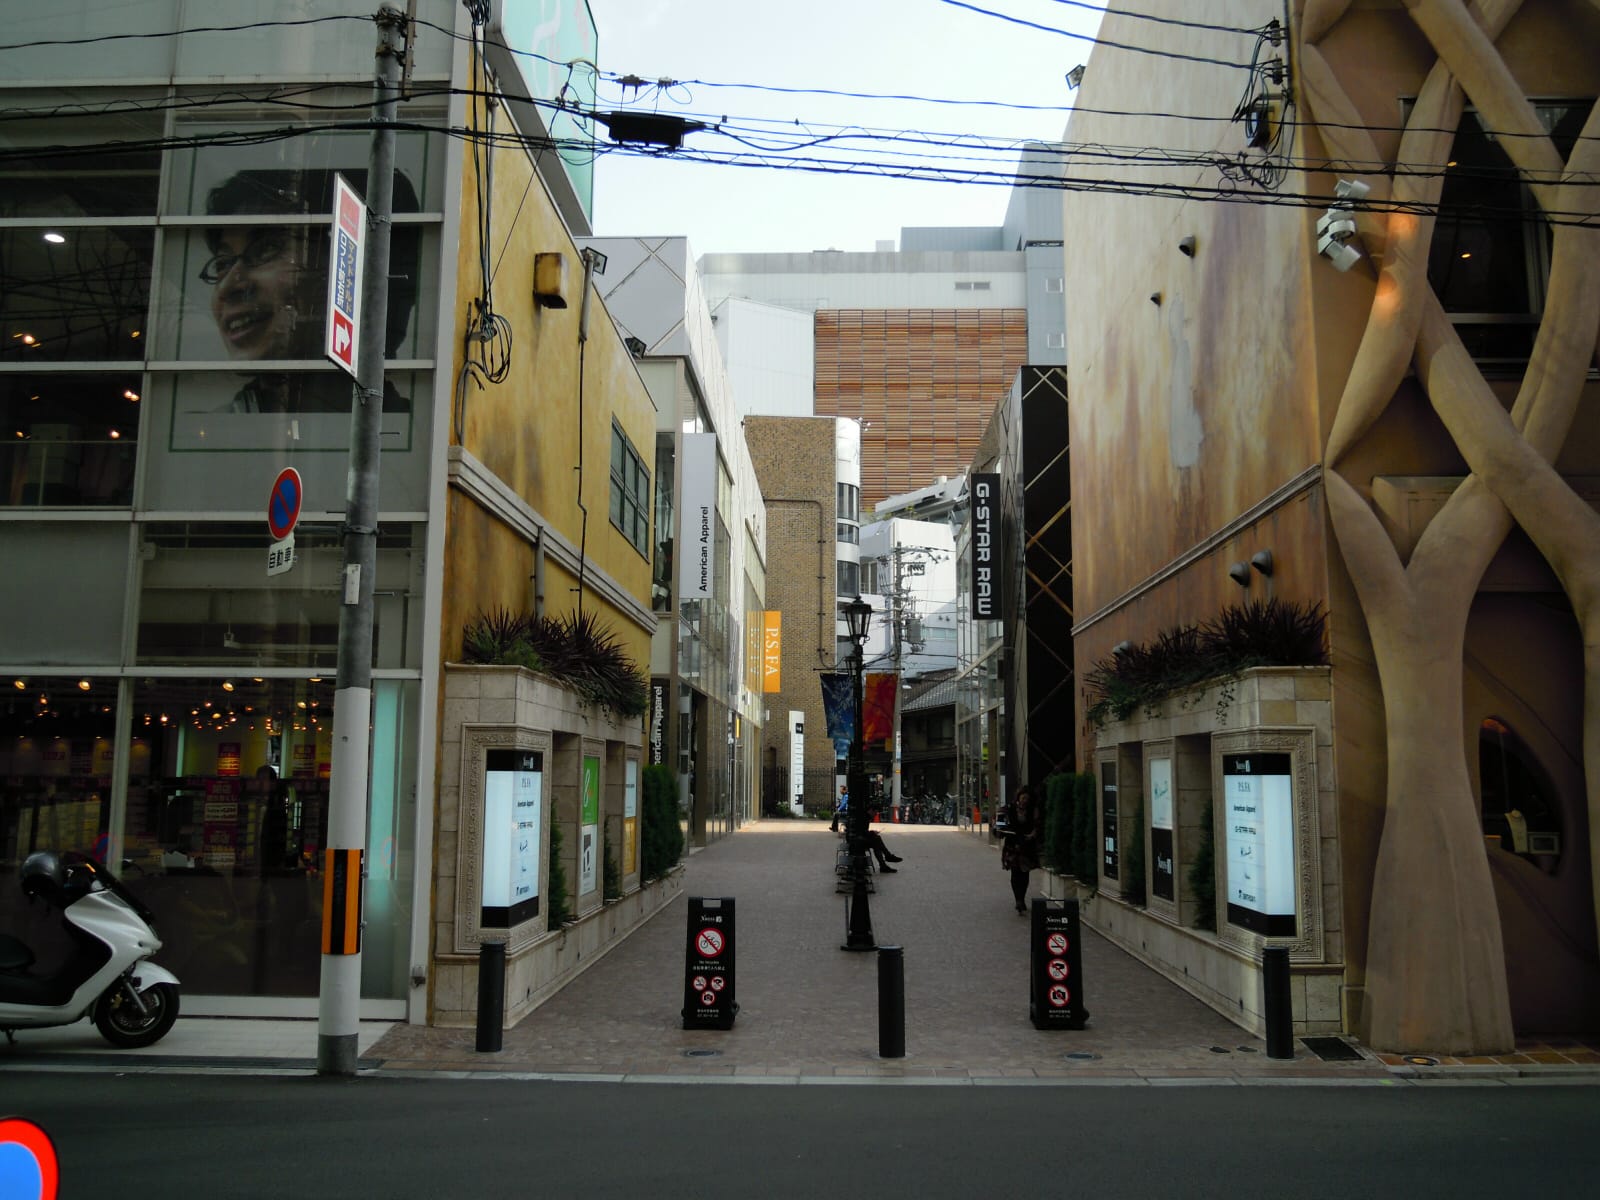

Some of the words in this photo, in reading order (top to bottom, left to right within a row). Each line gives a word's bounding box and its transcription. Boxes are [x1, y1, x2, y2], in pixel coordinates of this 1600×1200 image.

[699, 505, 710, 542] Apparel
[699, 546, 709, 592] American
[977, 567, 992, 615] RAW
[653, 686, 664, 725] Apparel
